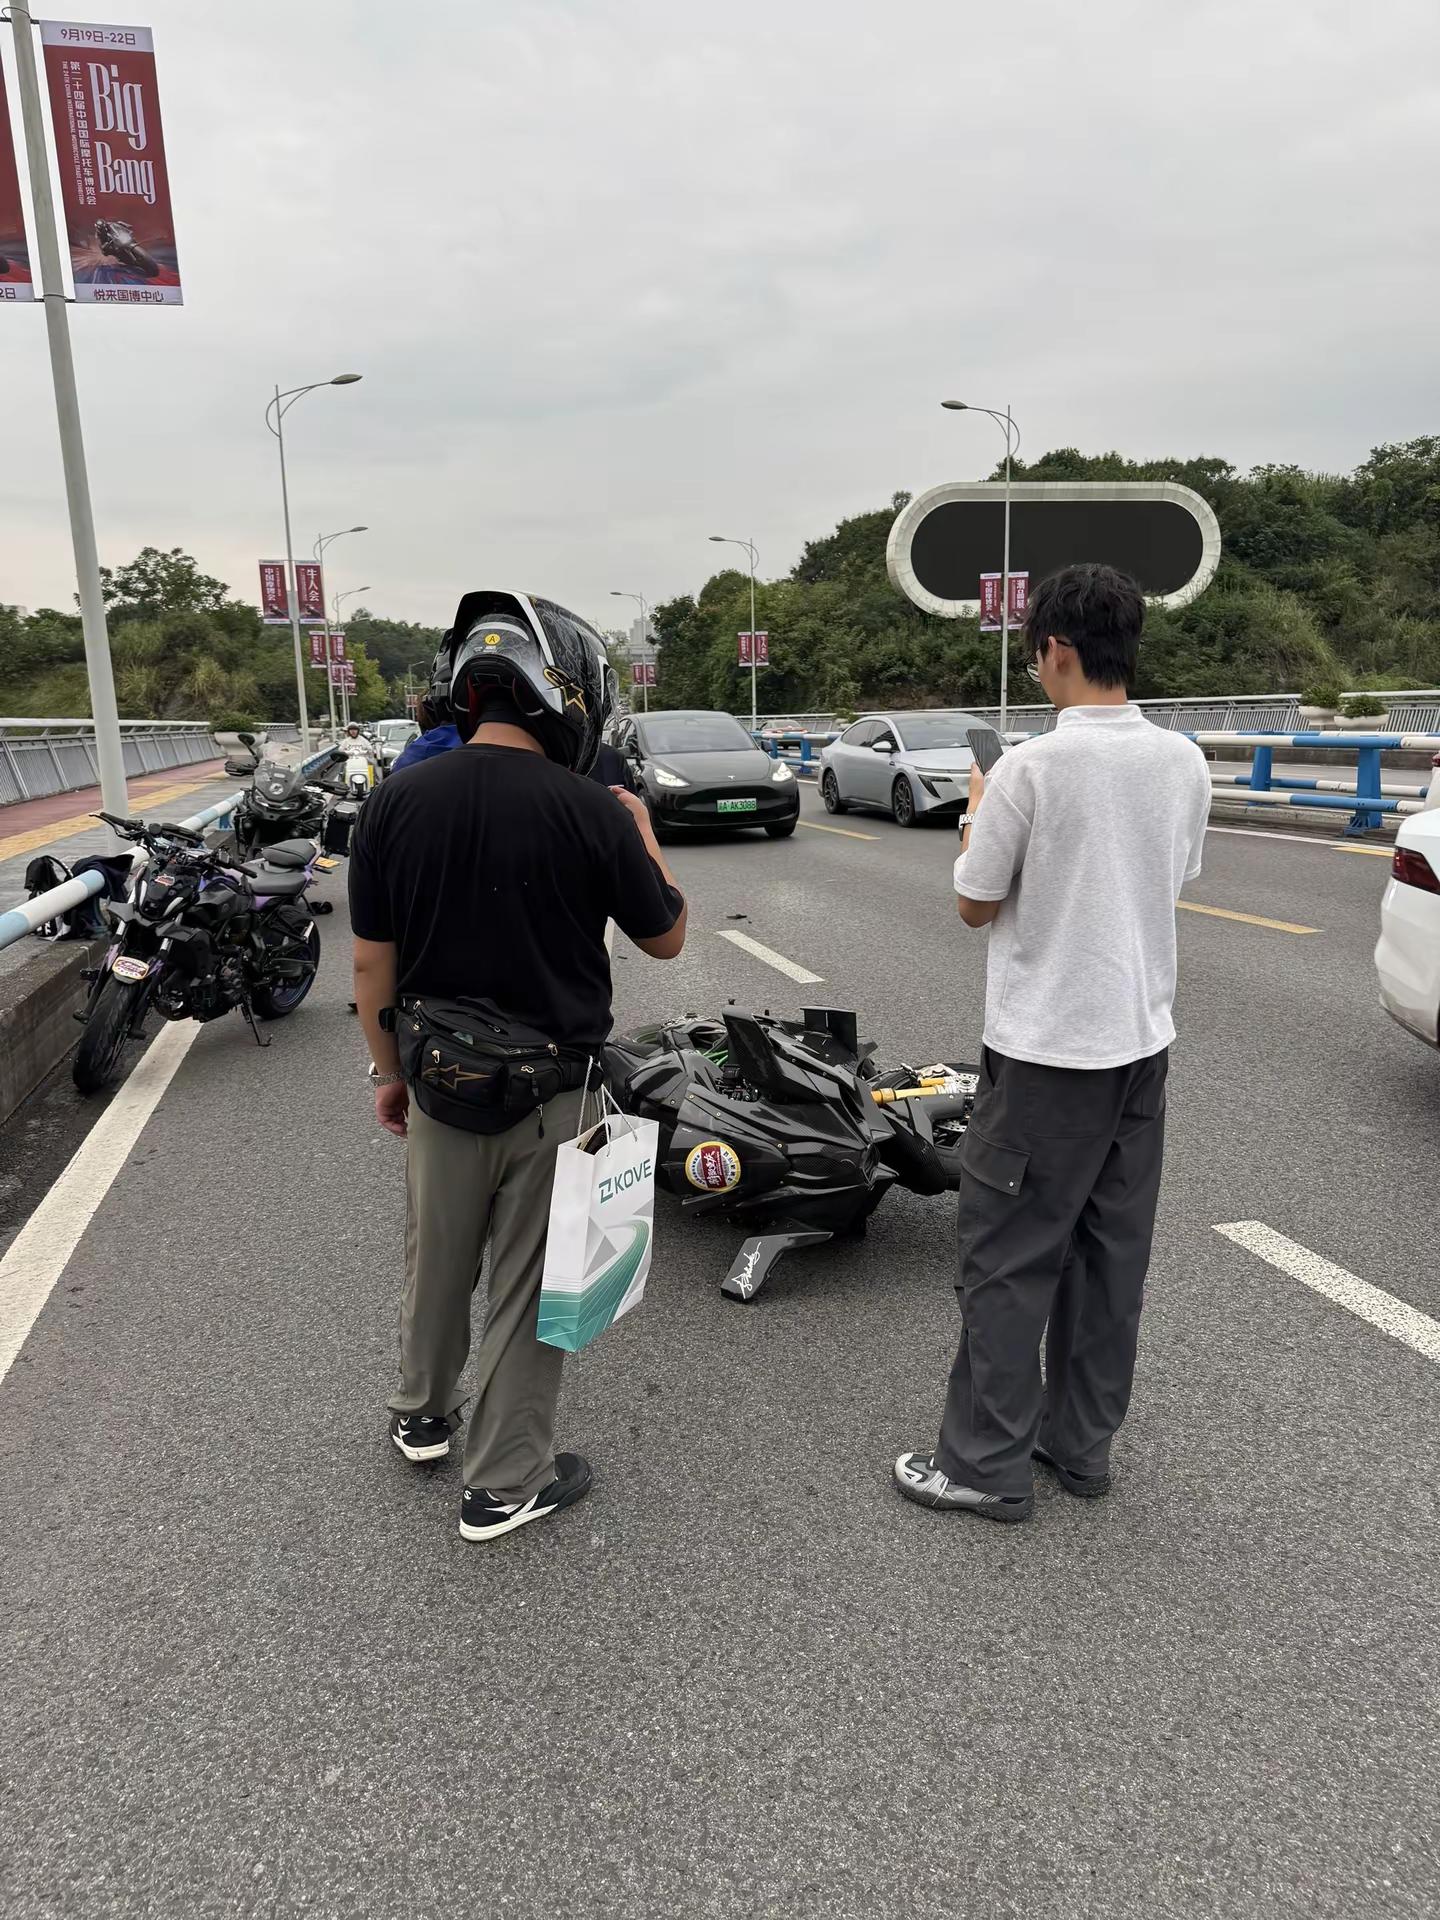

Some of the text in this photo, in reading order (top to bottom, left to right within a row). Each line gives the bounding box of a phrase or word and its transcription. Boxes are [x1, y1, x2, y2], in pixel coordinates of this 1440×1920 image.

[60, 28, 136, 45] 9月19日-22日
[87, 62, 147, 151] Big
[70, 61, 96, 205] 第二十四届中国国际摩托车博览会
[95, 141, 157, 205] Bang
[94, 288, 164, 302] 悦来国博中心
[306, 568, 320, 602] 牛人会
[614, 1158, 652, 1194] KOVE
